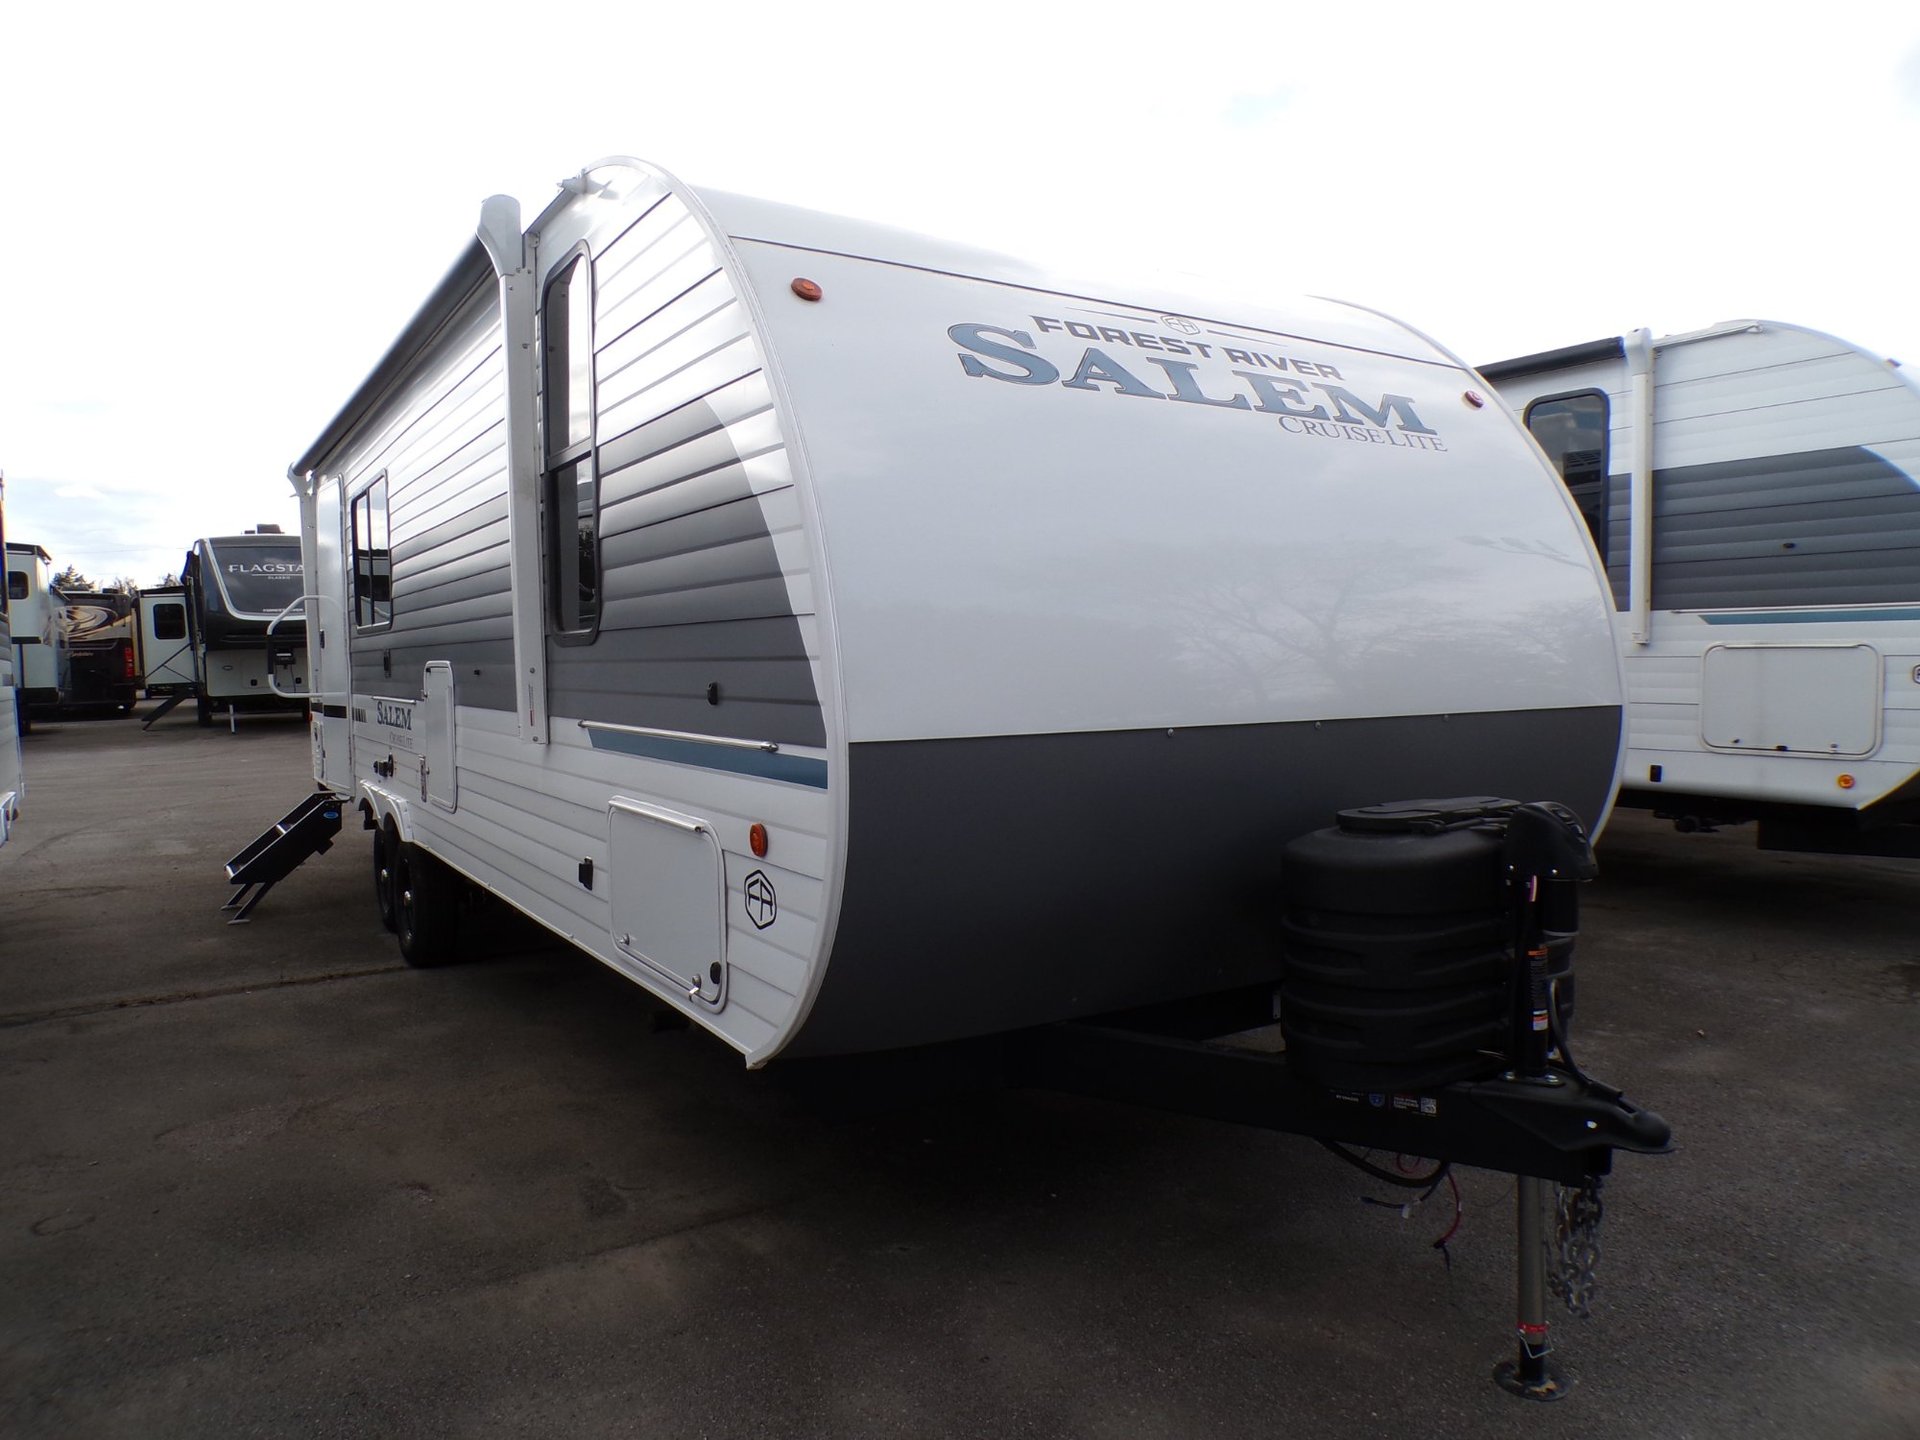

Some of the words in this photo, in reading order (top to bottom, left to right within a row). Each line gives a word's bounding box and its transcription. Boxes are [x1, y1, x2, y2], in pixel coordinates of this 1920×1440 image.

[946, 322, 1438, 436] SALEM
[1029, 315, 1213, 359] FOREST
[1223, 347, 1345, 381] RIVER
[376, 701, 412, 730] SALEM
